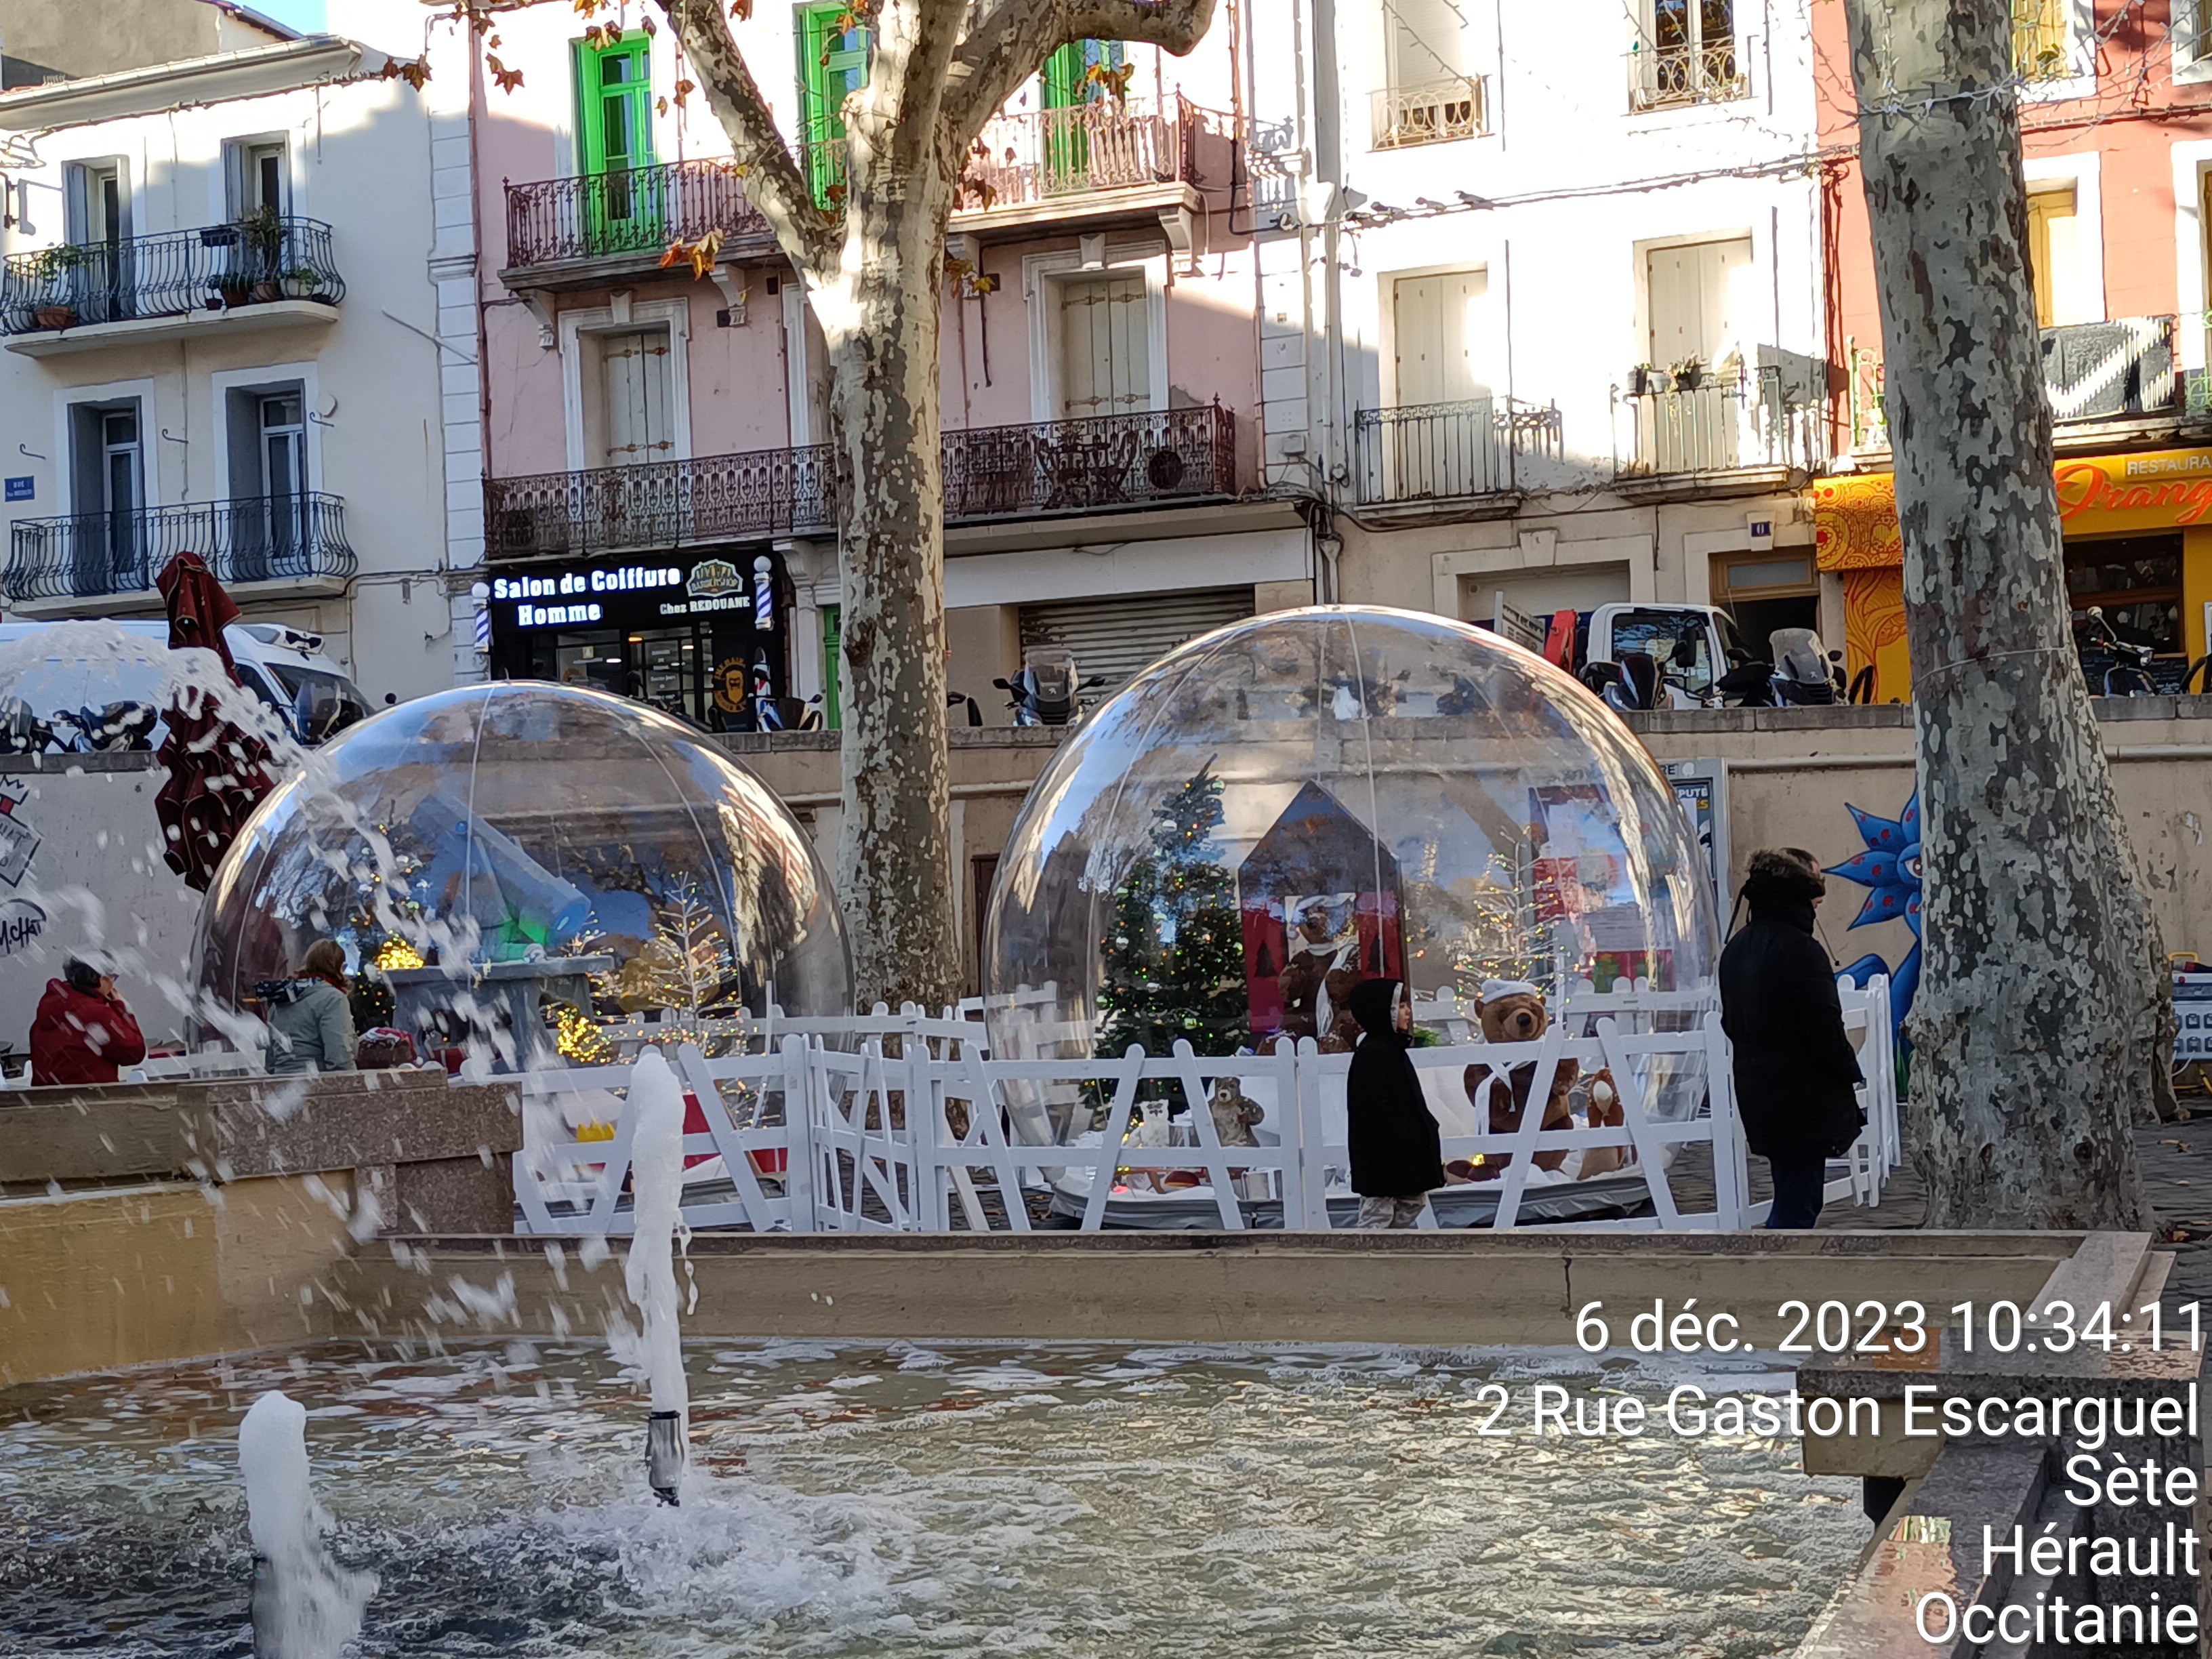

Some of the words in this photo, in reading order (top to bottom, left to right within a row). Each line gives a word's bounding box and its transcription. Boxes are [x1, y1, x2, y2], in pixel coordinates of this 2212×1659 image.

[2127, 455, 2212, 476] RESTAURA
[494, 576, 556, 599] Salon
[560, 573, 587, 594] de
[591, 567, 682, 592] Coiffure
[689, 596, 750, 612] REDOUANE
[518, 604, 602, 626] Homme
